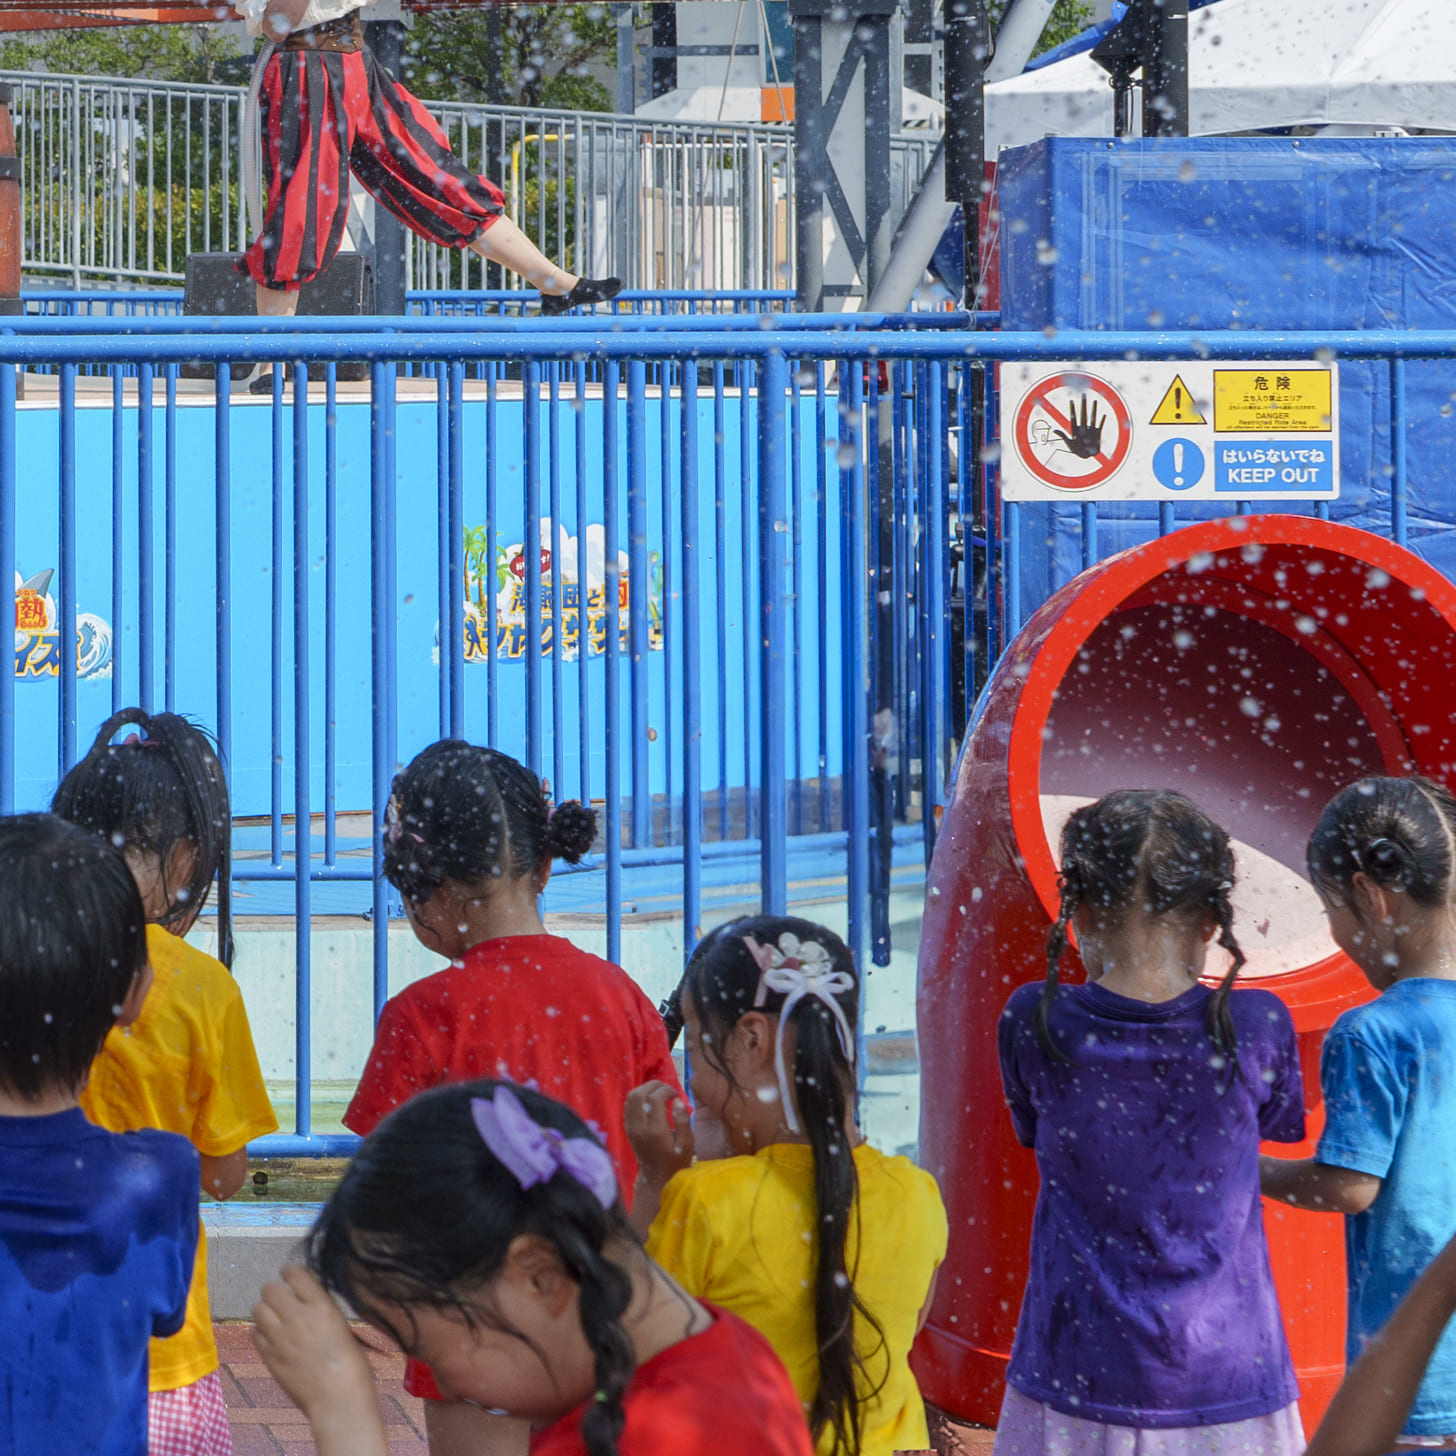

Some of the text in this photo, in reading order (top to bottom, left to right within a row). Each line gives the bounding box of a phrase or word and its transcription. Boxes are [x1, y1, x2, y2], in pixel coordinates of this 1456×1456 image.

[1254, 376, 1291, 391] 危険
[1223, 449, 1326, 464] はいらないでね
[1228, 468, 1319, 483] KEEP OUT
